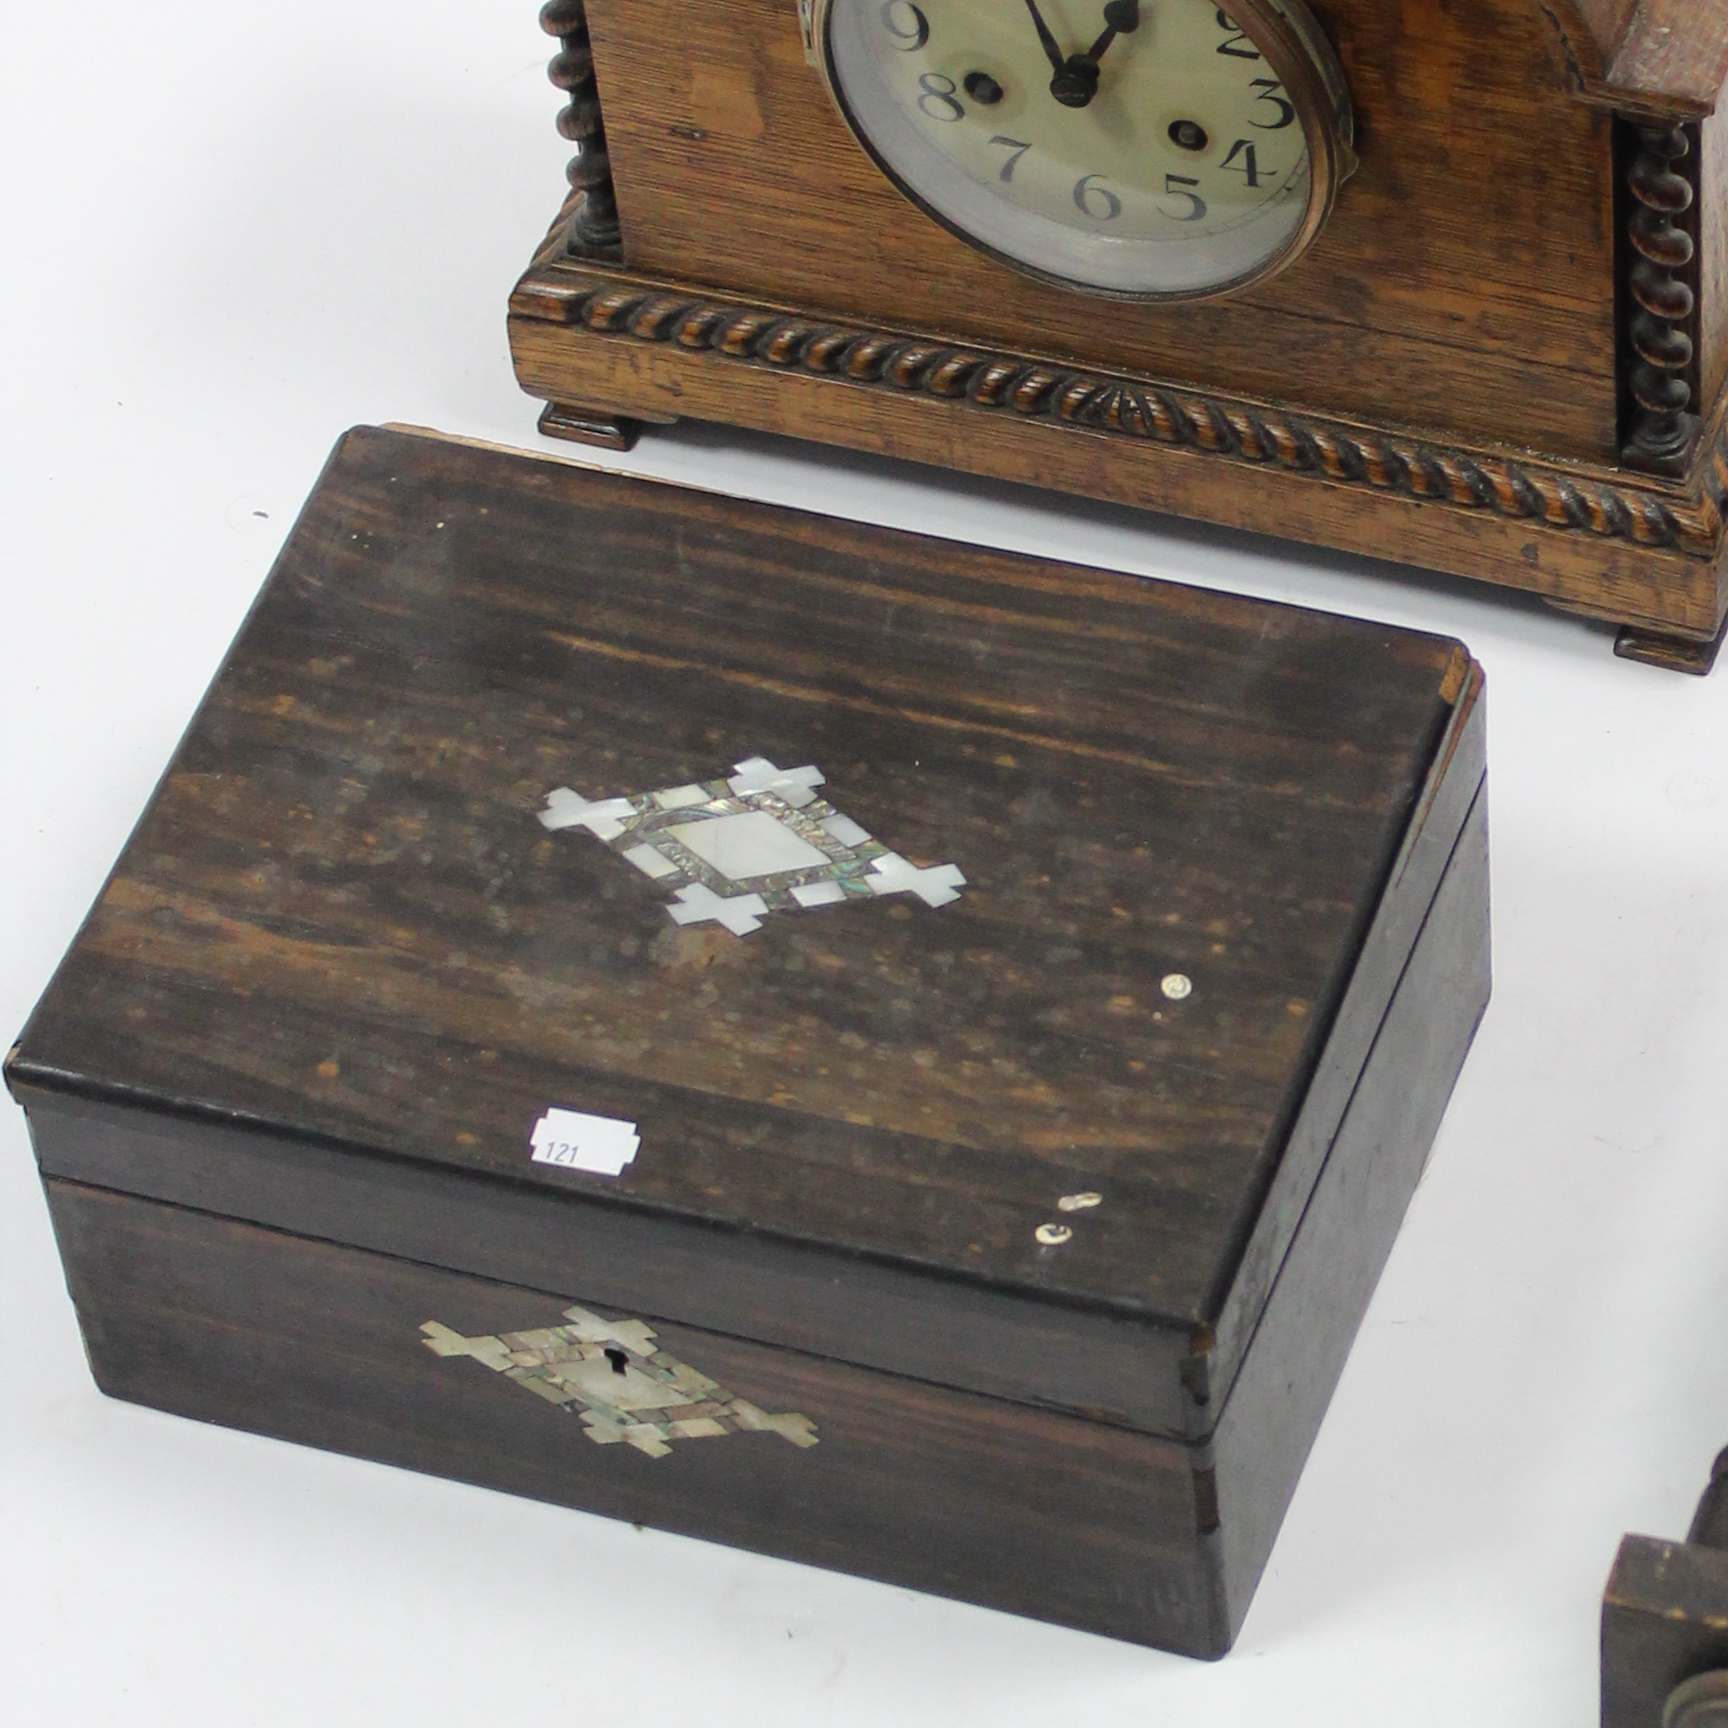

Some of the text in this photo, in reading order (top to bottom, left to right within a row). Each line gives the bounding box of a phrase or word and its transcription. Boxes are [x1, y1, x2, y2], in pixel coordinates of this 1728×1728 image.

[1216, 8, 1262, 60] 2
[918, 72, 966, 123] 8
[1247, 77, 1296, 130] 3
[989, 135, 1033, 184] 7
[1218, 138, 1278, 189] 4
[1072, 173, 1122, 222] 6
[1155, 173, 1208, 222] 5
[545, 1140, 579, 1164] 121
